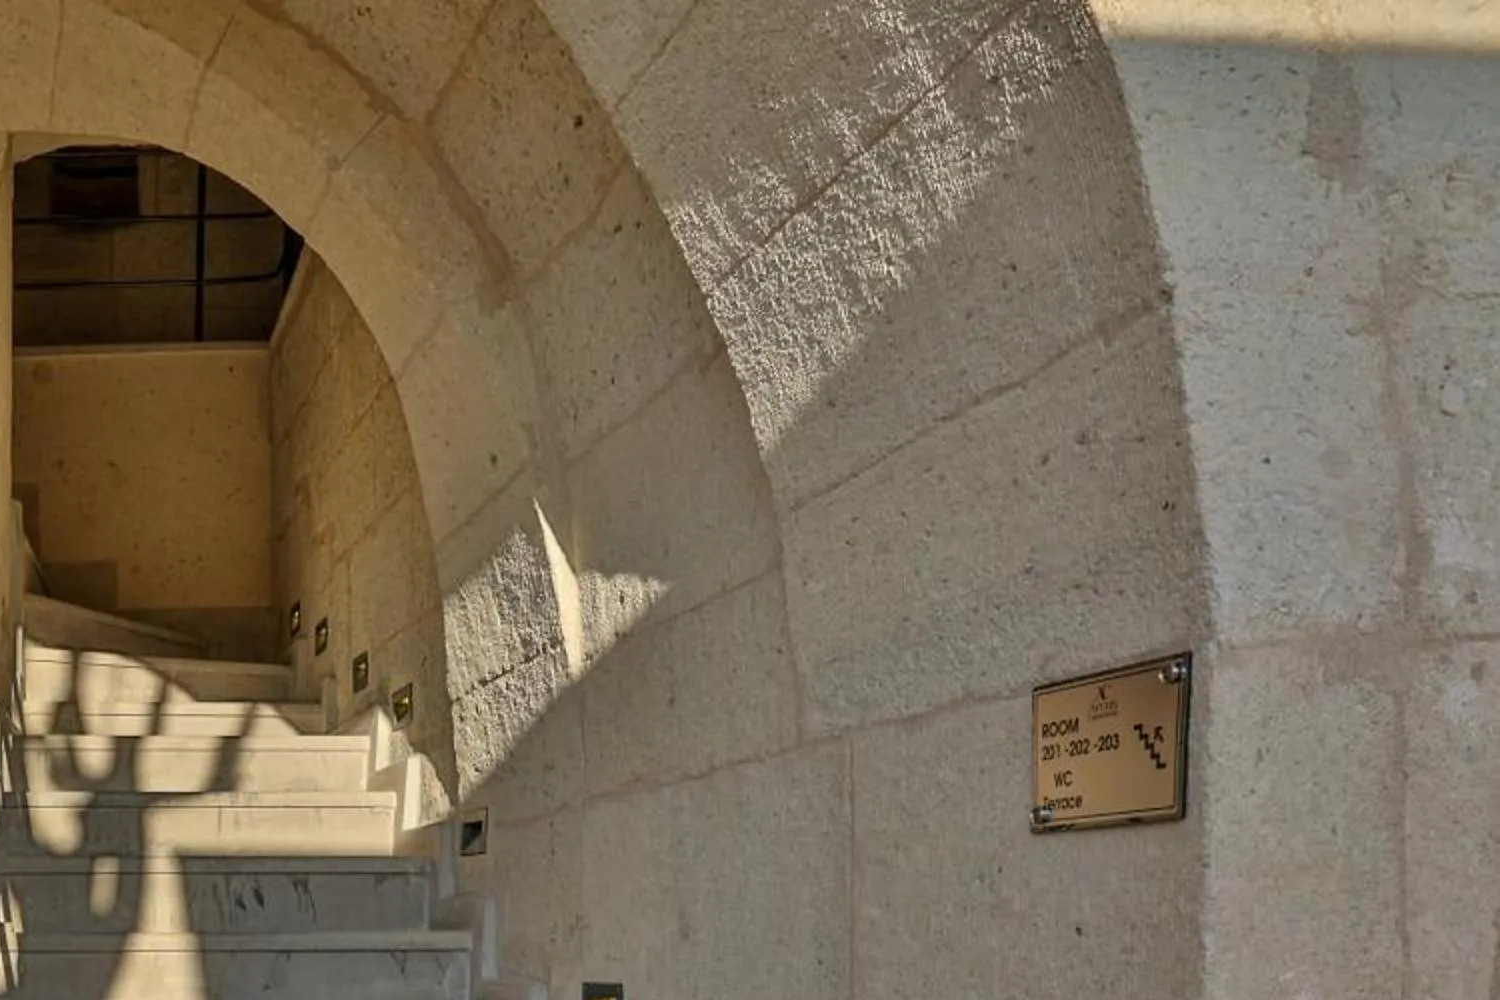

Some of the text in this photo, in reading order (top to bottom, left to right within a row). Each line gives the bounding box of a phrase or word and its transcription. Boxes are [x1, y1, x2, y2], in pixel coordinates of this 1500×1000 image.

[1042, 717, 1079, 738] ROOM
[1042, 743, 1060, 760] 201
[1053, 770, 1073, 788] WC
